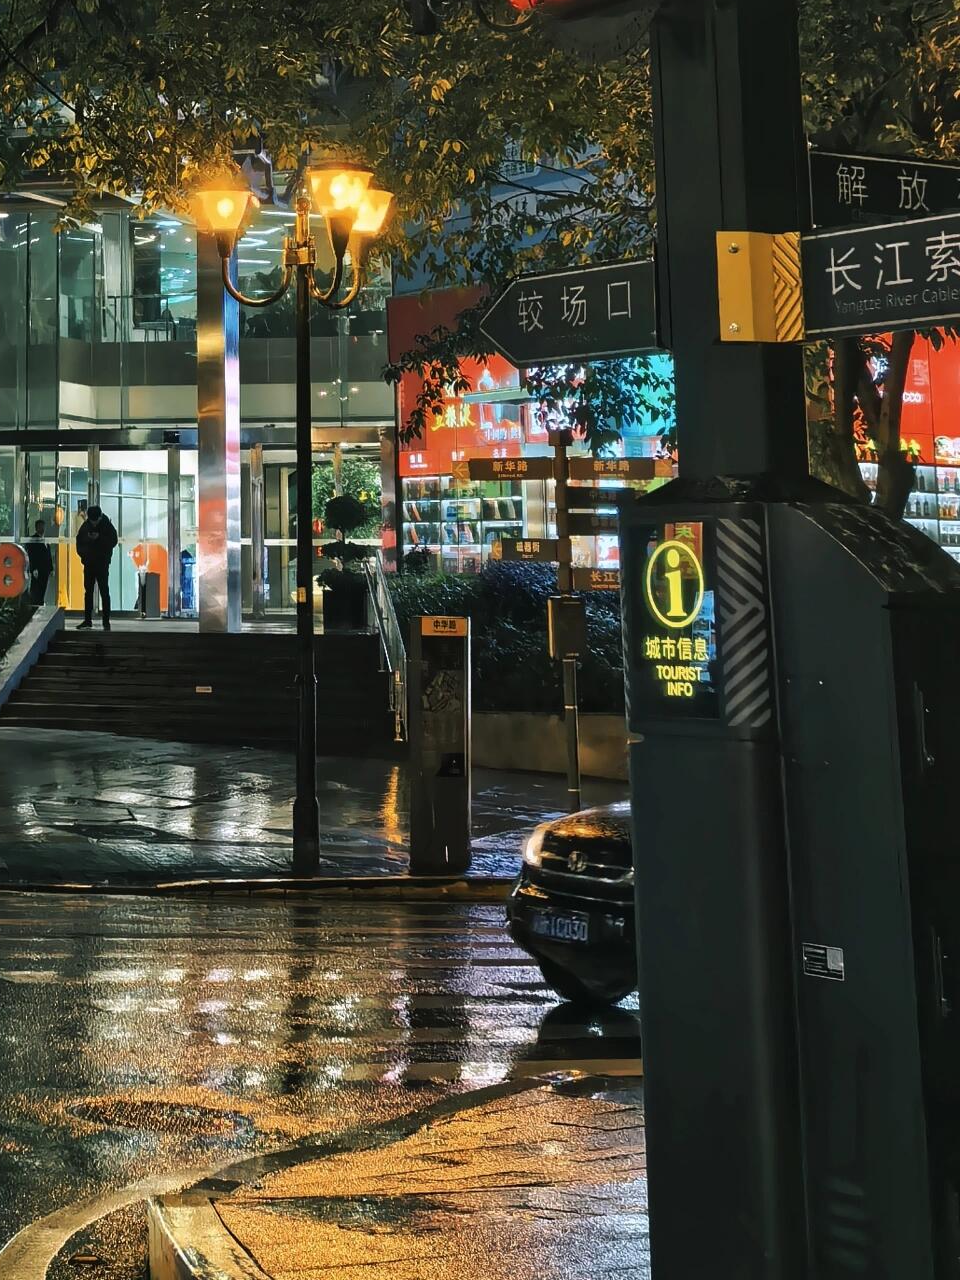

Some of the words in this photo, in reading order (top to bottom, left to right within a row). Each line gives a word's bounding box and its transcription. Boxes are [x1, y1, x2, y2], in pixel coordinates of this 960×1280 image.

[836, 163, 960, 211] 解放
[517, 280, 633, 334] 较场口
[886, 293, 918, 309] River
[645, 636, 710, 661] 城市信息
[656, 665, 703, 681] TOURIST
[667, 682, 693, 697] INFO
